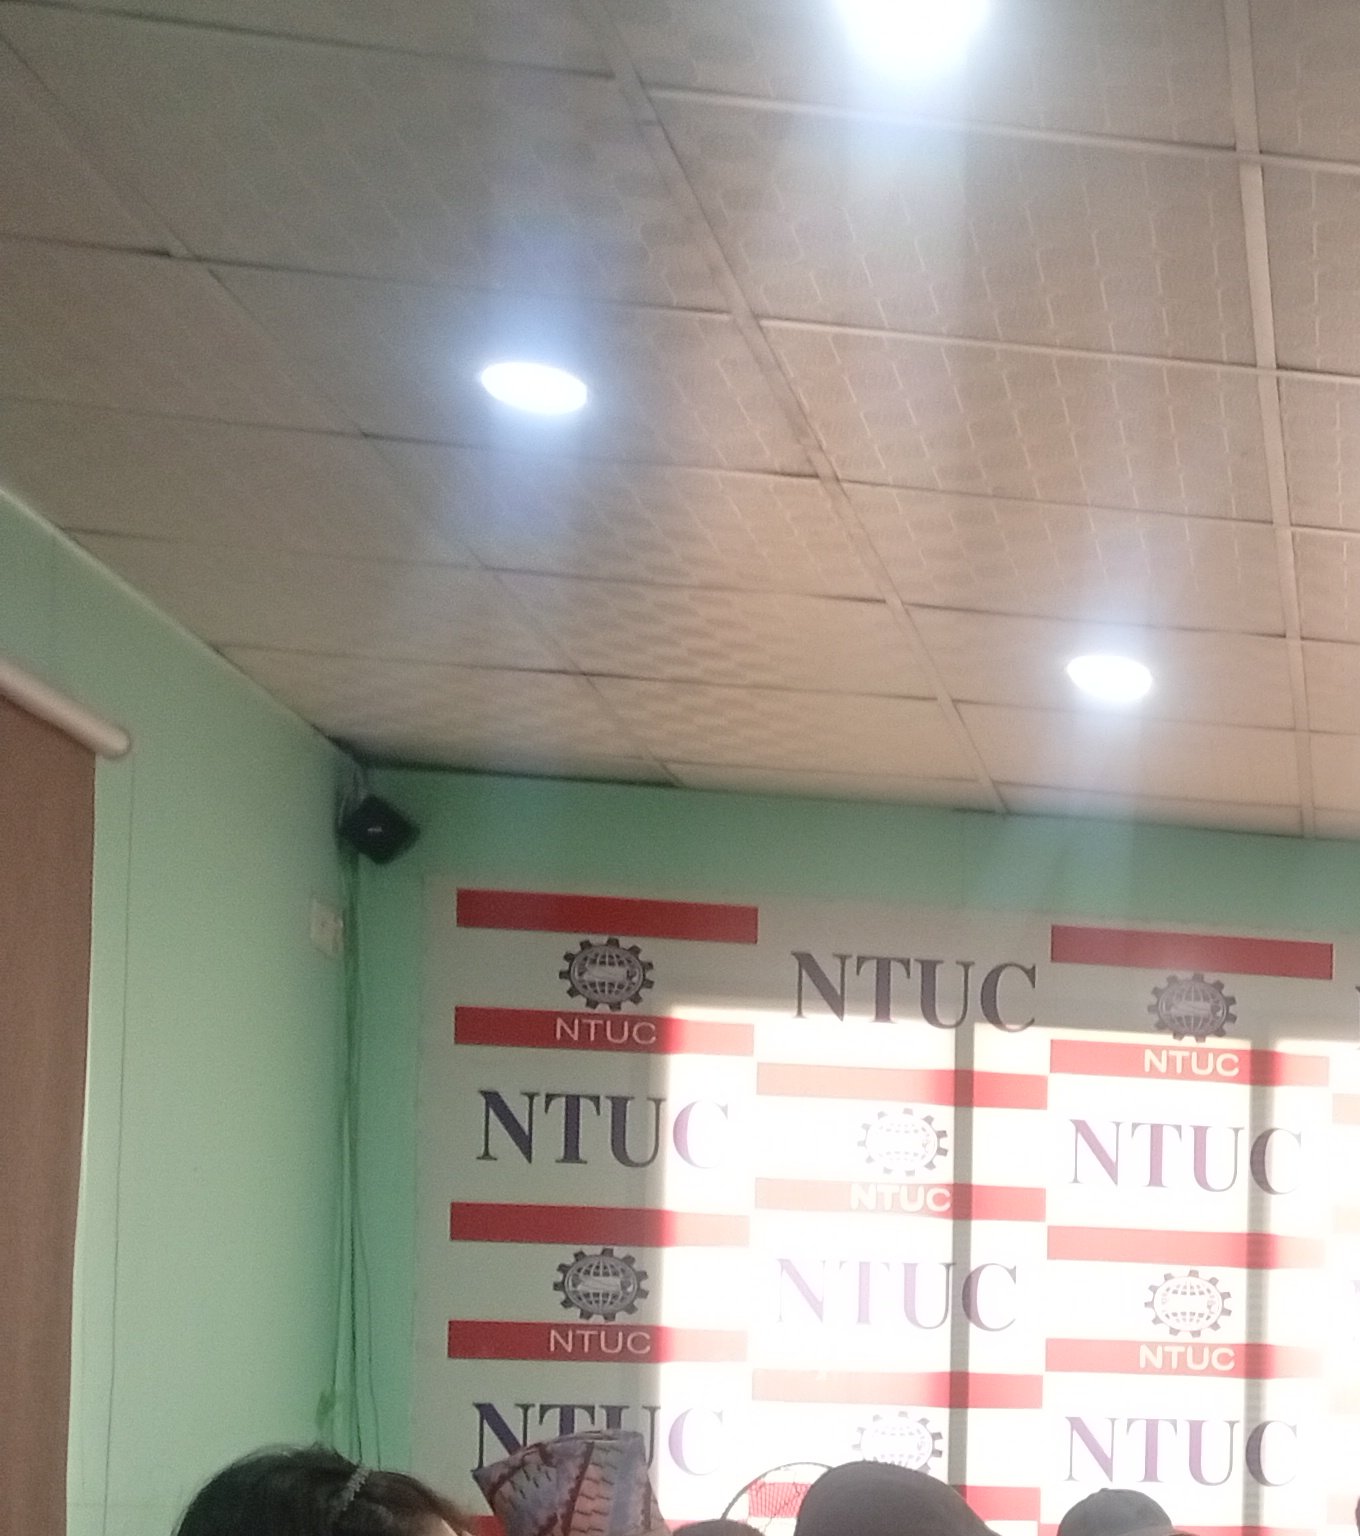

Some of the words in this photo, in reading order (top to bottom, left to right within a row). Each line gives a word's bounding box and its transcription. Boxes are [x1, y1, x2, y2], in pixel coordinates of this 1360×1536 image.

[791, 950, 1037, 1033] NTUC
[554, 1017, 658, 1045] NTUC
[1143, 1050, 1239, 1076] NTUC
[476, 1089, 729, 1169] NTUC
[1068, 1119, 1302, 1195] NTUC
[850, 1183, 952, 1212] NTUC
[776, 1258, 1017, 1331] NTUC
[548, 1329, 651, 1355] NTUC
[1139, 1344, 1236, 1371] NTUC
[1064, 1417, 1298, 1487] NTUC
